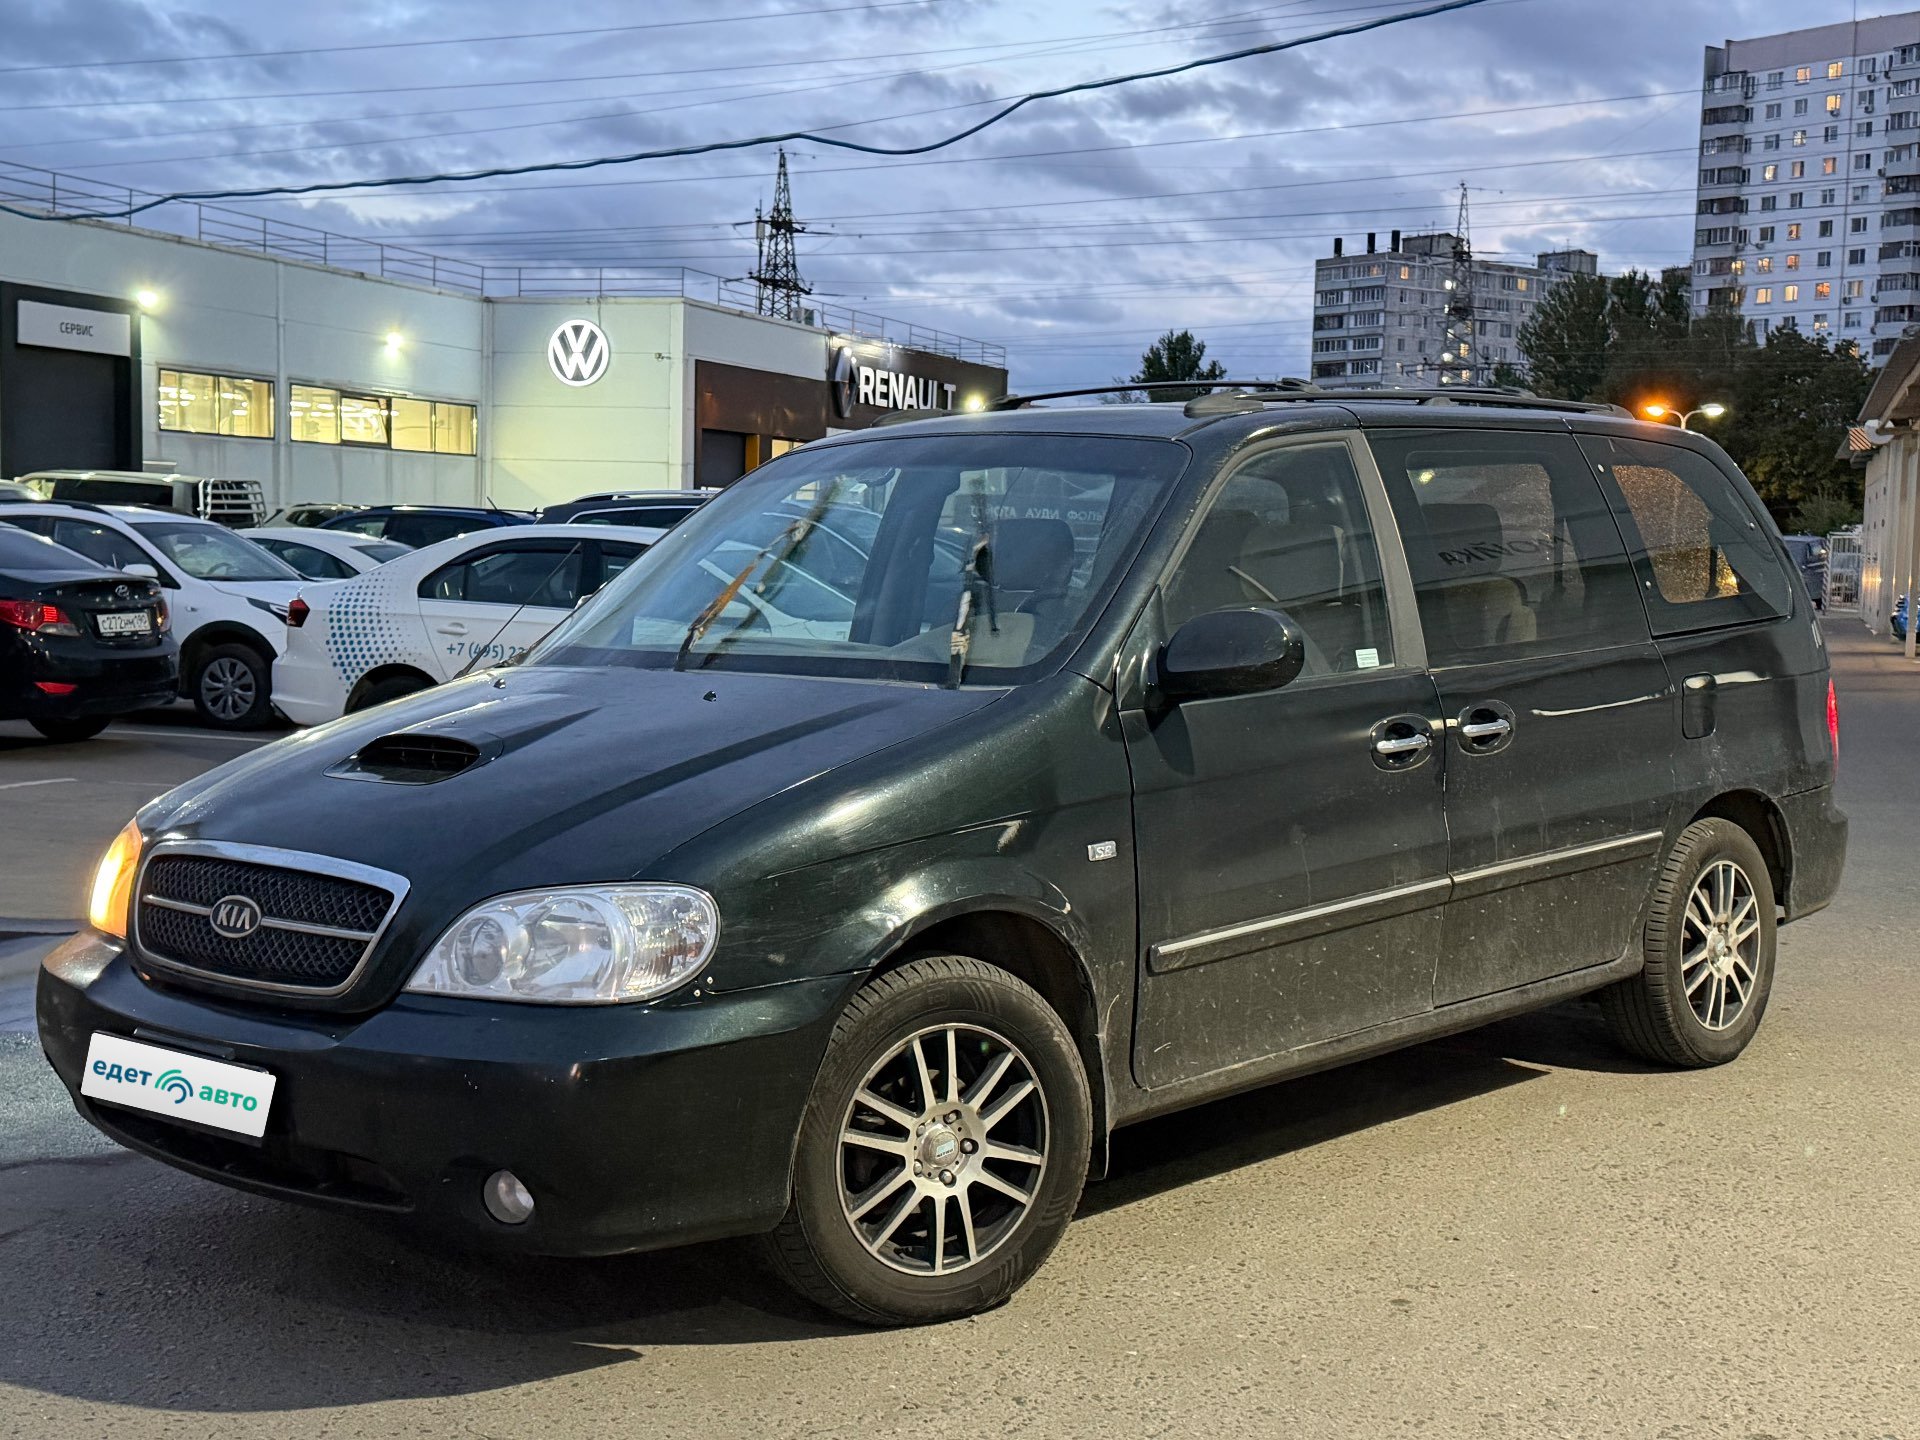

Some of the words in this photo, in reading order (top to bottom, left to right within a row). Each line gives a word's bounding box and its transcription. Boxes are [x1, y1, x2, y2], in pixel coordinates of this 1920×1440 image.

[60, 322, 94, 337] СЕРВИС
[858, 365, 956, 411] RENAULT
[970, 505, 1016, 518] ТЙОТА
[1025, 507, 1060, 519] АУДИ
[446, 642, 465, 656] +7
[216, 903, 250, 930] KIA
